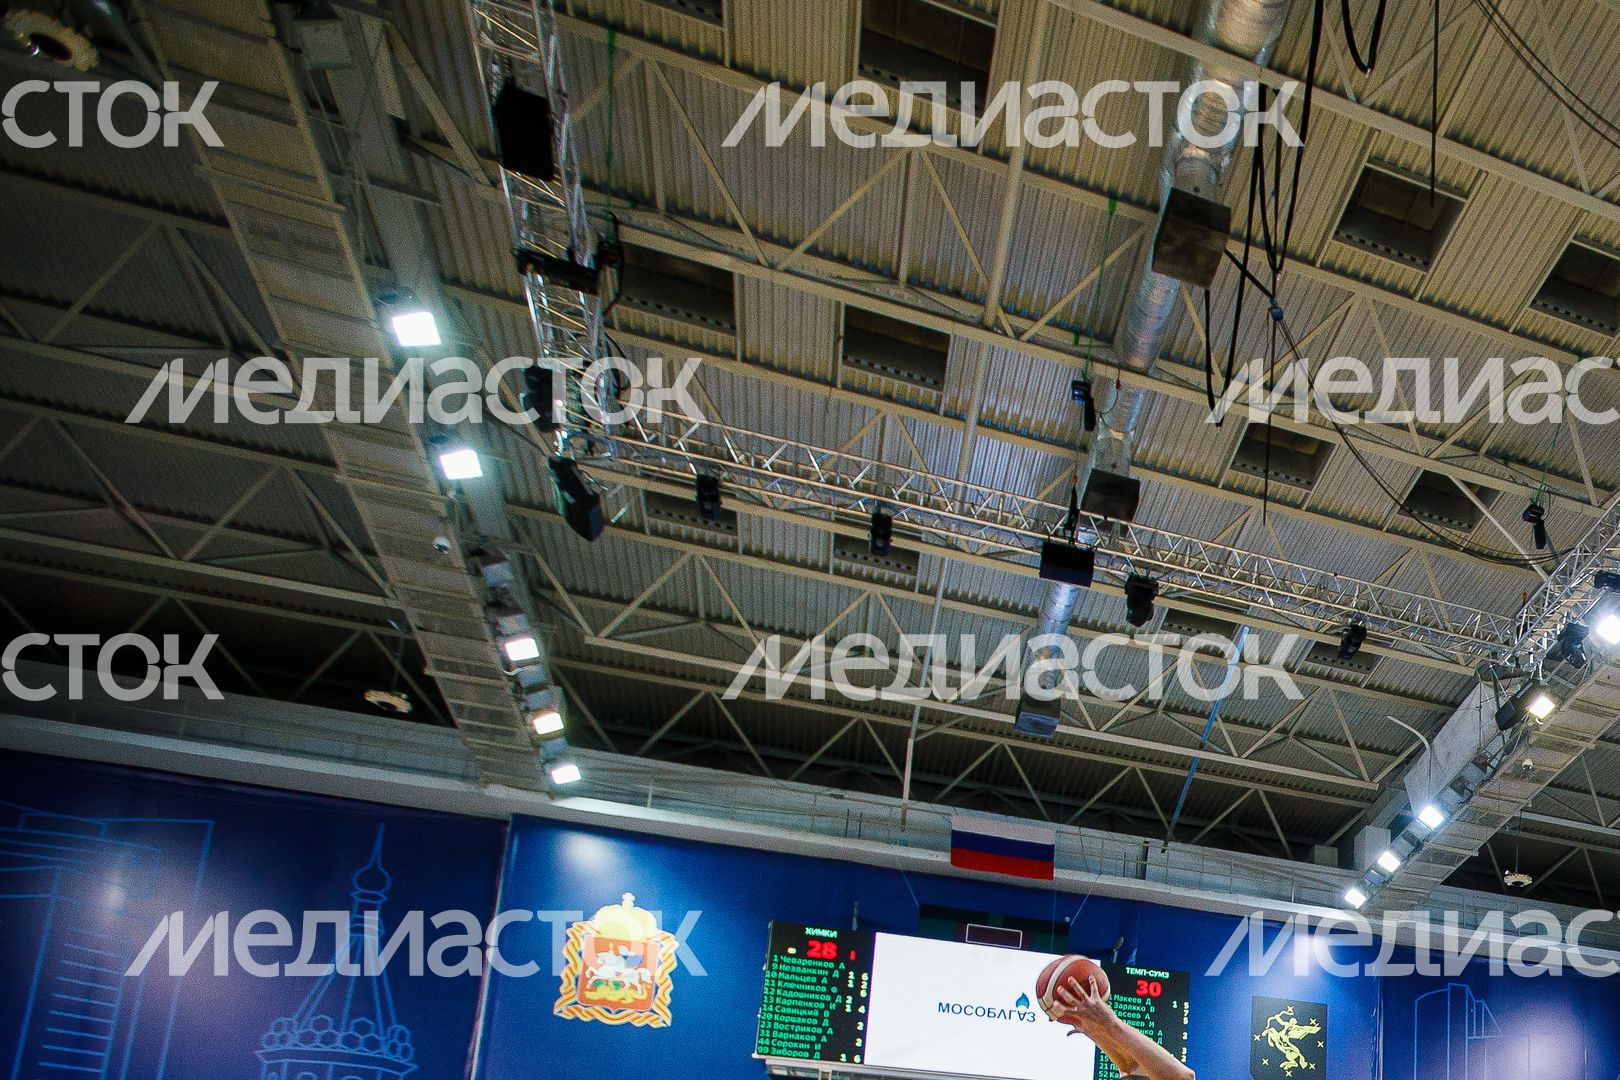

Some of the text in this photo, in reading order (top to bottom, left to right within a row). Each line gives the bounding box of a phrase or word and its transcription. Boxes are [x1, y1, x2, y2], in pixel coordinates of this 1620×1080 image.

[805, 927, 838, 939] ХИМКИ
[806, 939, 838, 960] 28
[773, 954, 778, 962] 1
[772, 962, 778, 970] 9
[765, 970, 778, 979] 10
[1126, 966, 1170, 979] ТЕМП-СУМЗ
[764, 978, 776, 987] 11
[763, 987, 775, 995] 12
[1135, 979, 1163, 998] 30
[763, 995, 774, 1004] 13
[1113, 994, 1142, 1004] Макеев
[1172, 1000, 1178, 1009] 1
[762, 1003, 773, 1012] 14
[761, 1012, 773, 1020] 20
[938, 1002, 1036, 1023] МОСОБЛГАЗ
[760, 1020, 772, 1029] 23
[759, 1029, 770, 1037] 31
[758, 1037, 770, 1045] 44
[757, 1046, 769, 1054] 99
[1099, 1062, 1108, 1070] 21
[1099, 1070, 1108, 1078] 52
